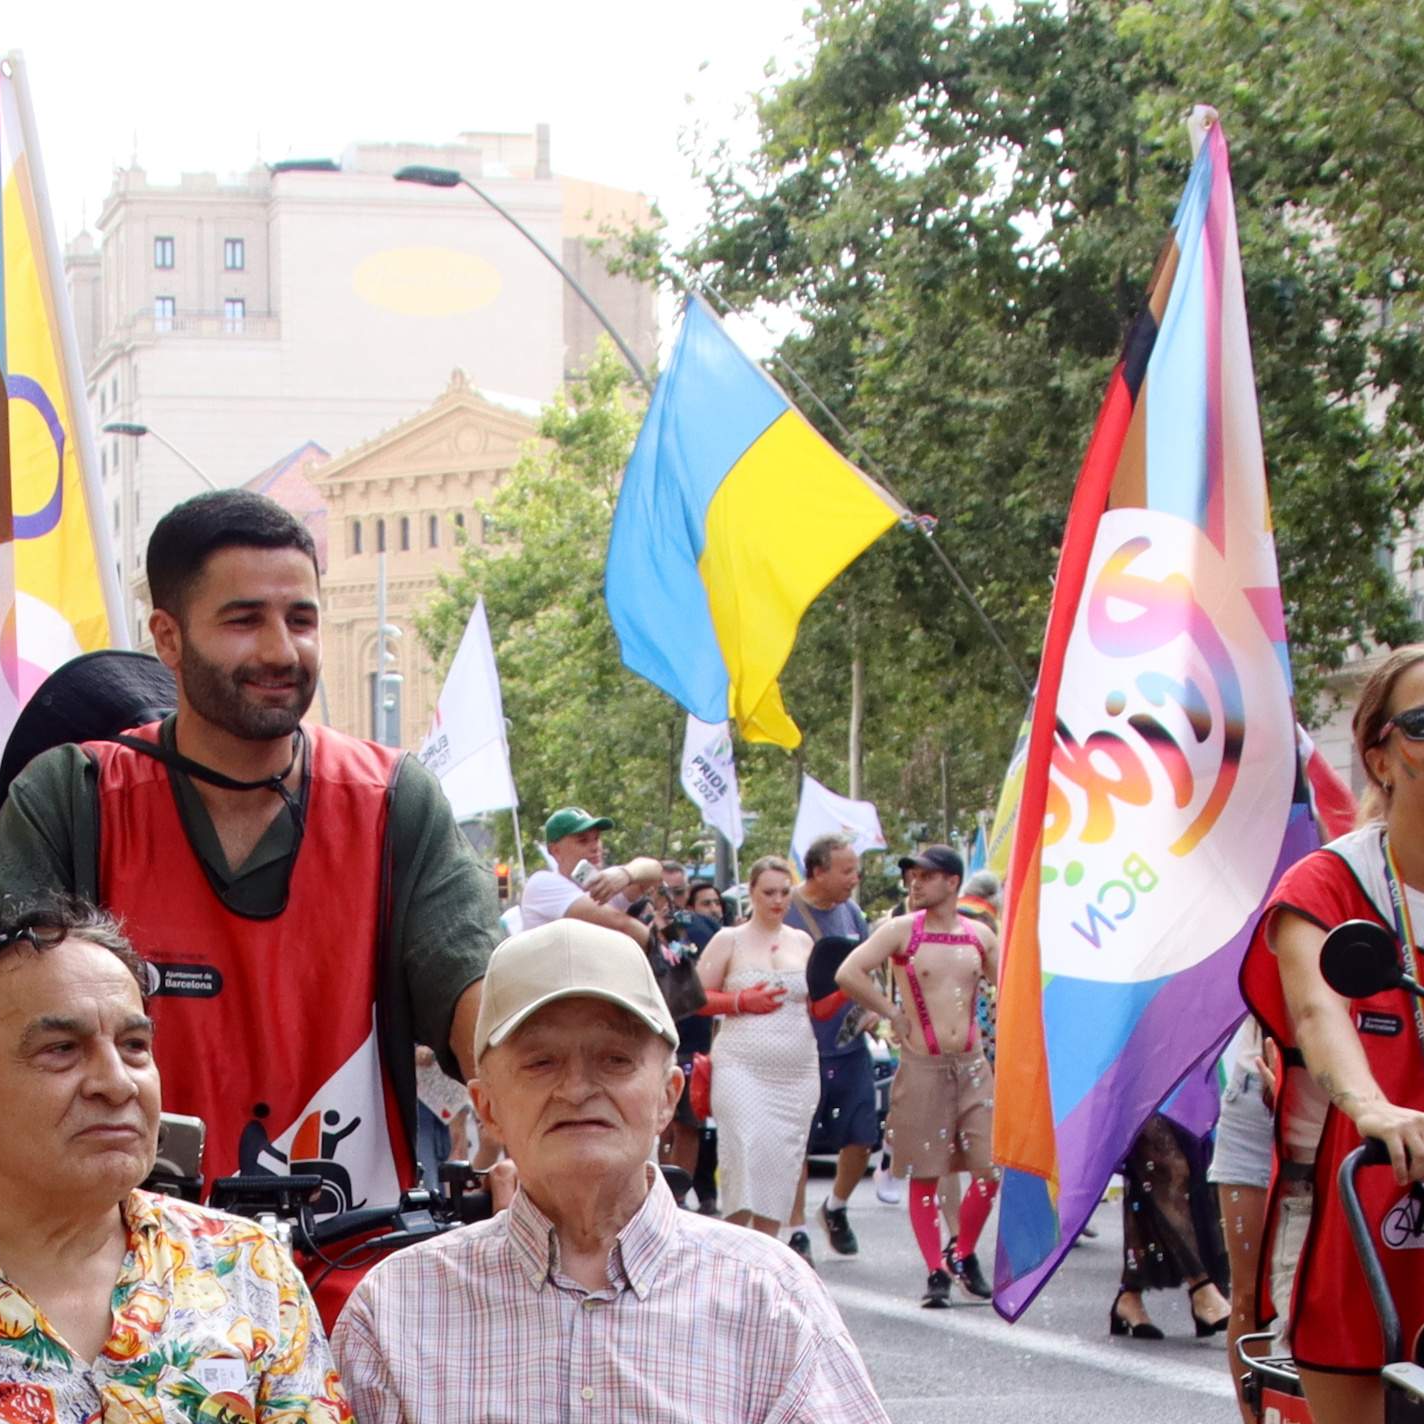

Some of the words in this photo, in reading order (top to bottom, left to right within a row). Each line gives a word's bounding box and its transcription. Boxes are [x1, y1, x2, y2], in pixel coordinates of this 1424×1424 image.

[691, 754, 728, 796] PRIDE
[164, 970, 203, 980] Ajuntament
[164, 979, 213, 990] Barcelona
